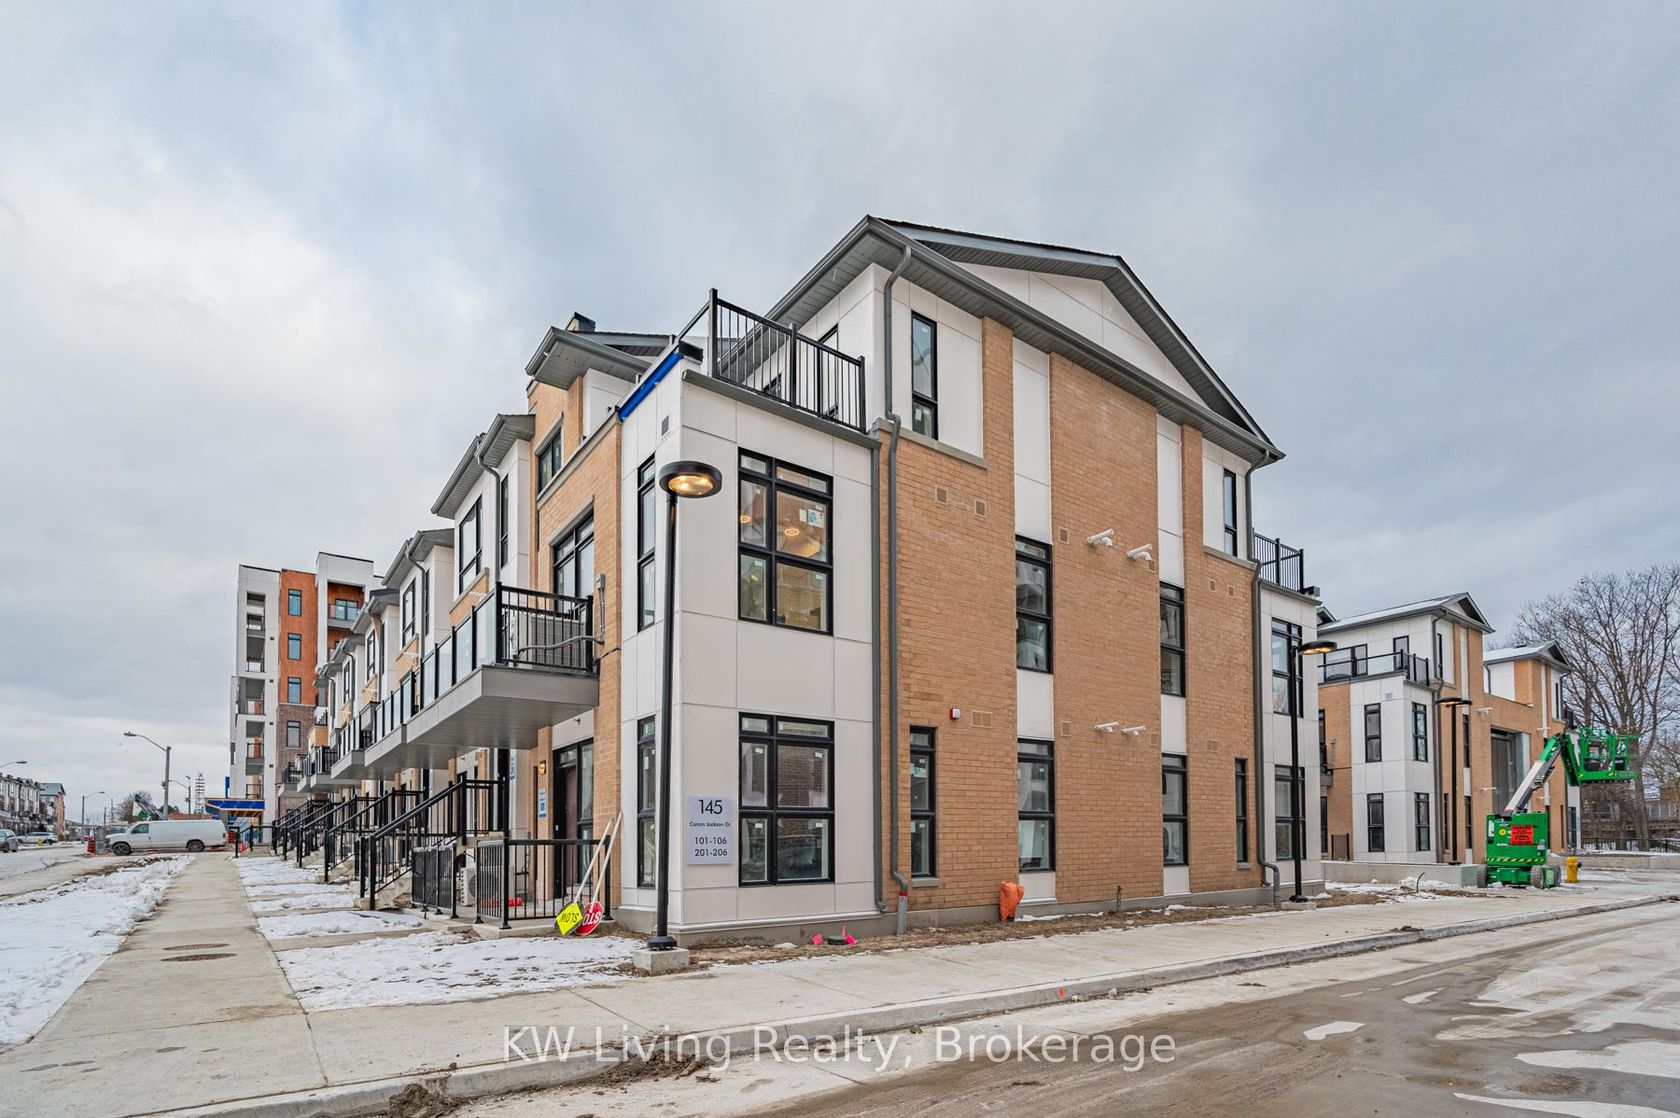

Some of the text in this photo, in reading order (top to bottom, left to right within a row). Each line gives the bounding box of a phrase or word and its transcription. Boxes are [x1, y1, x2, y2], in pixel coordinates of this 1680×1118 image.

[698, 799, 723, 814] 145
[695, 836, 727, 845] 101-106
[694, 848, 728, 857] 201-206
[582, 911, 602, 925] STO
